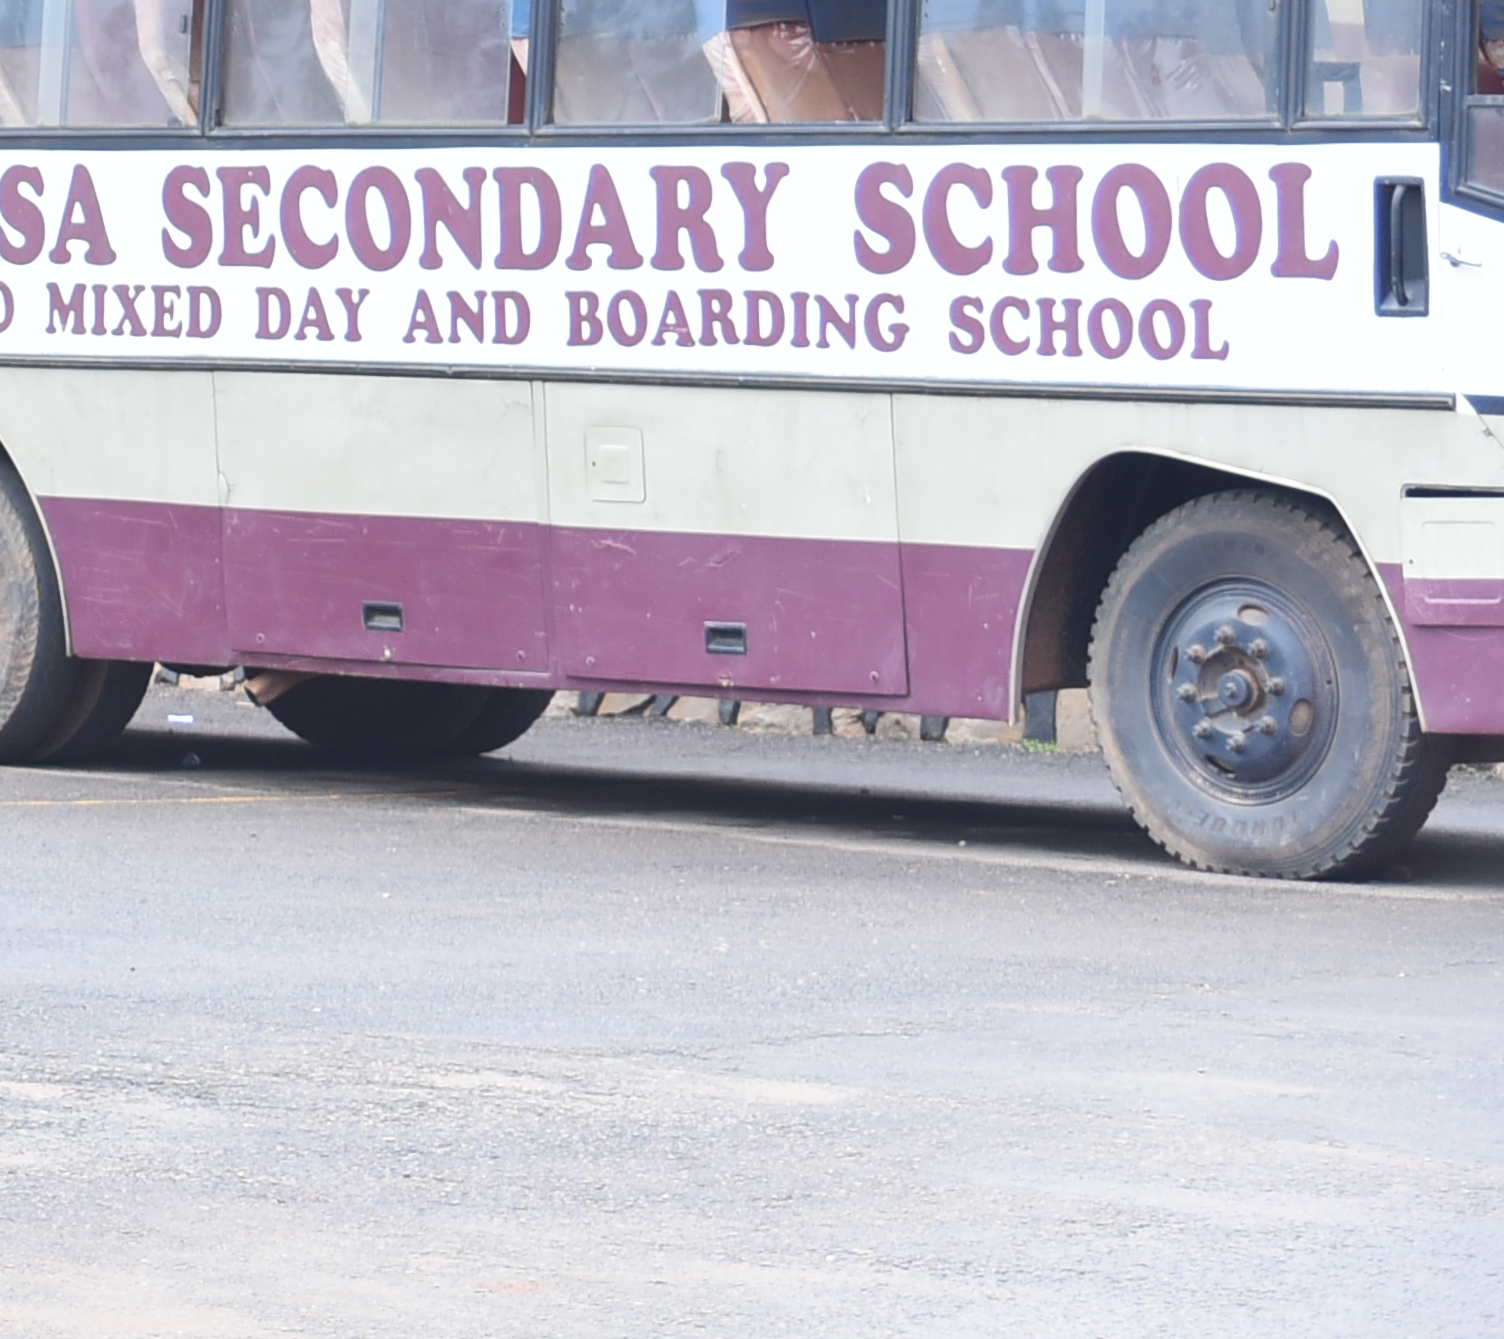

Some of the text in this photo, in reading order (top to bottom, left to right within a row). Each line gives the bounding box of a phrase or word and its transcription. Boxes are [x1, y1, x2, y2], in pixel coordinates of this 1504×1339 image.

[161, 161, 790, 272] SECONDARY
[853, 161, 1340, 281] SCHOOL
[45, 281, 223, 339] MIXED
[254, 285, 371, 343] DAY
[402, 288, 531, 346] AND
[564, 288, 911, 353] BOARDING
[948, 294, 1230, 361] SCHOOL
